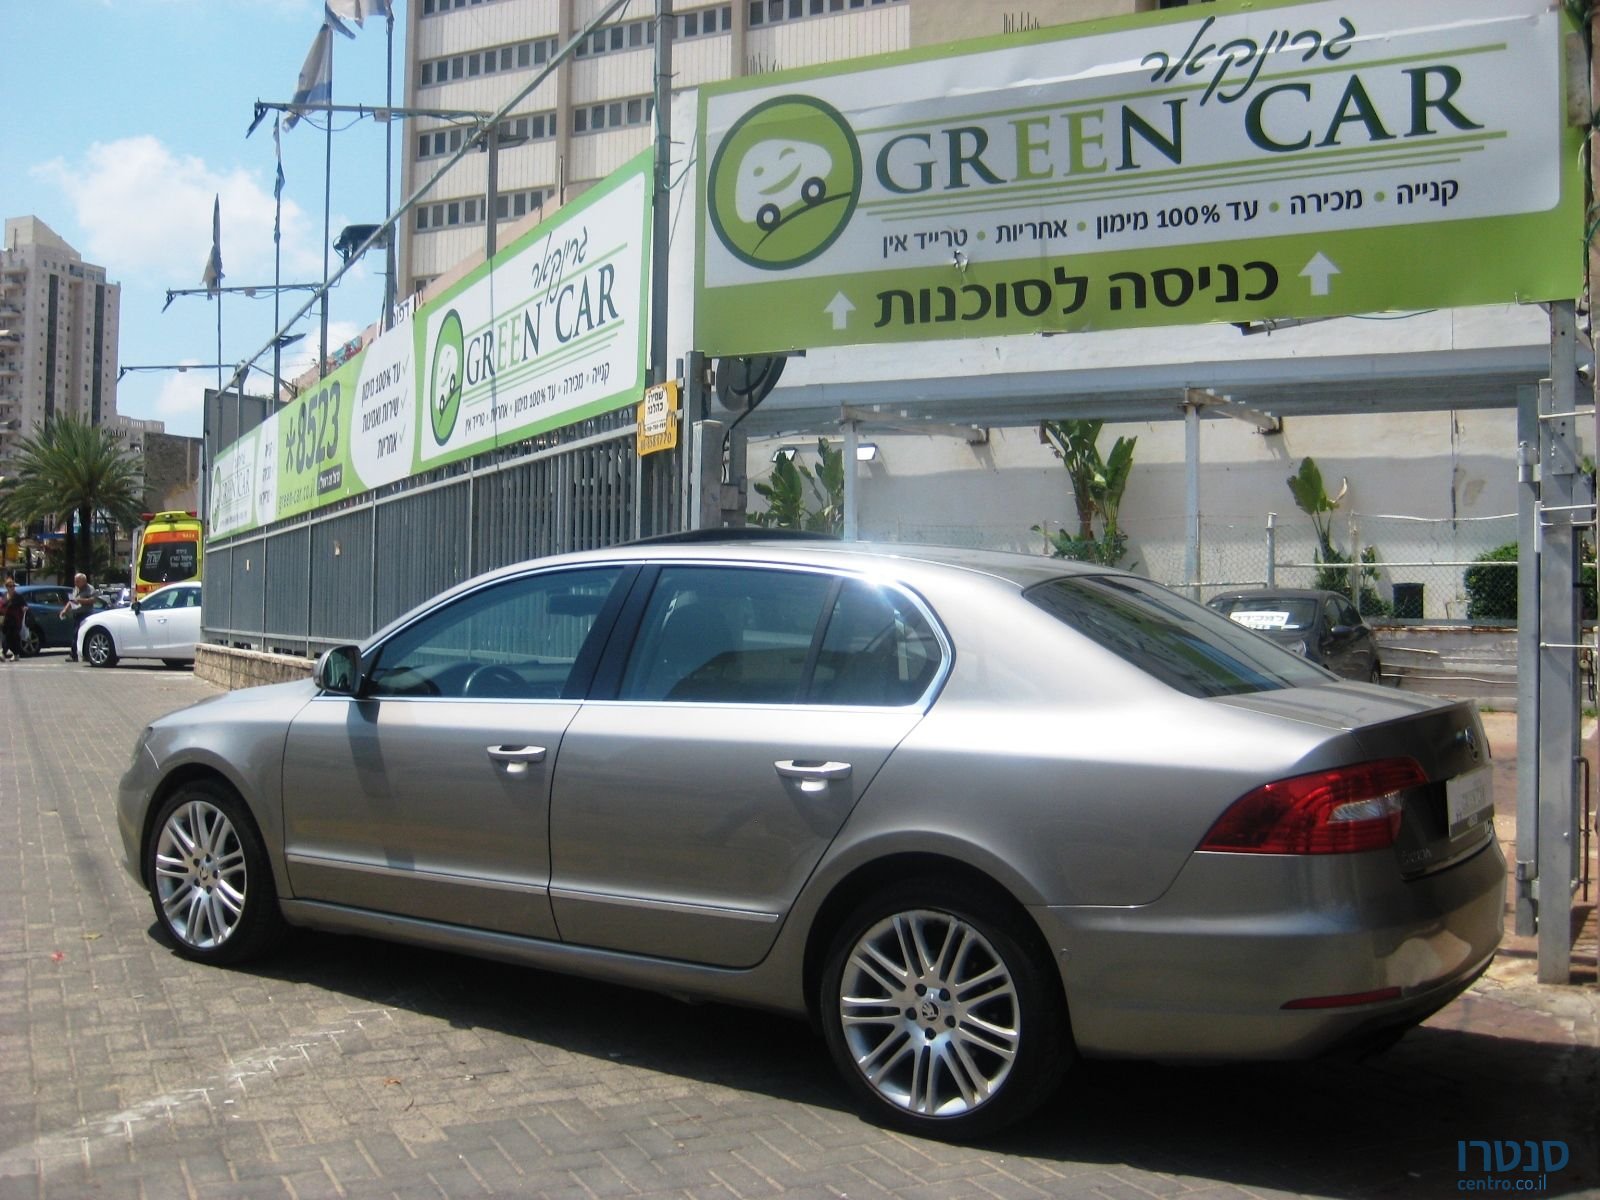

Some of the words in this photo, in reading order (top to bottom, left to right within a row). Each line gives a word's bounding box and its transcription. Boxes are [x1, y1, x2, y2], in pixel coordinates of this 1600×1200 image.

[1141, 16, 1356, 106] גרינקאר
[876, 98, 1187, 194] GREEN
[1245, 64, 1485, 152] CAR
[1290, 189, 1363, 215] מכירה
[1396, 179, 1459, 206] קנייה
[1156, 204, 1220, 228] 100%
[1226, 199, 1258, 221] עד
[995, 219, 1067, 244] אחריות
[1096, 211, 1148, 239] מימון
[883, 234, 907, 258] אין
[914, 228, 968, 249] טרייד
[874, 266, 1088, 328] לסוכנות
[1108, 261, 1279, 310] כניסה
[466, 301, 542, 386] GREEN
[555, 263, 619, 343] CAR
[375, 369, 391, 395] 100%
[393, 361, 401, 382] עד
[563, 372, 584, 395] מכירה
[592, 362, 610, 387] קנייה
[529, 389, 546, 408] 100%
[548, 383, 556, 400] עד
[514, 394, 528, 418] מימון
